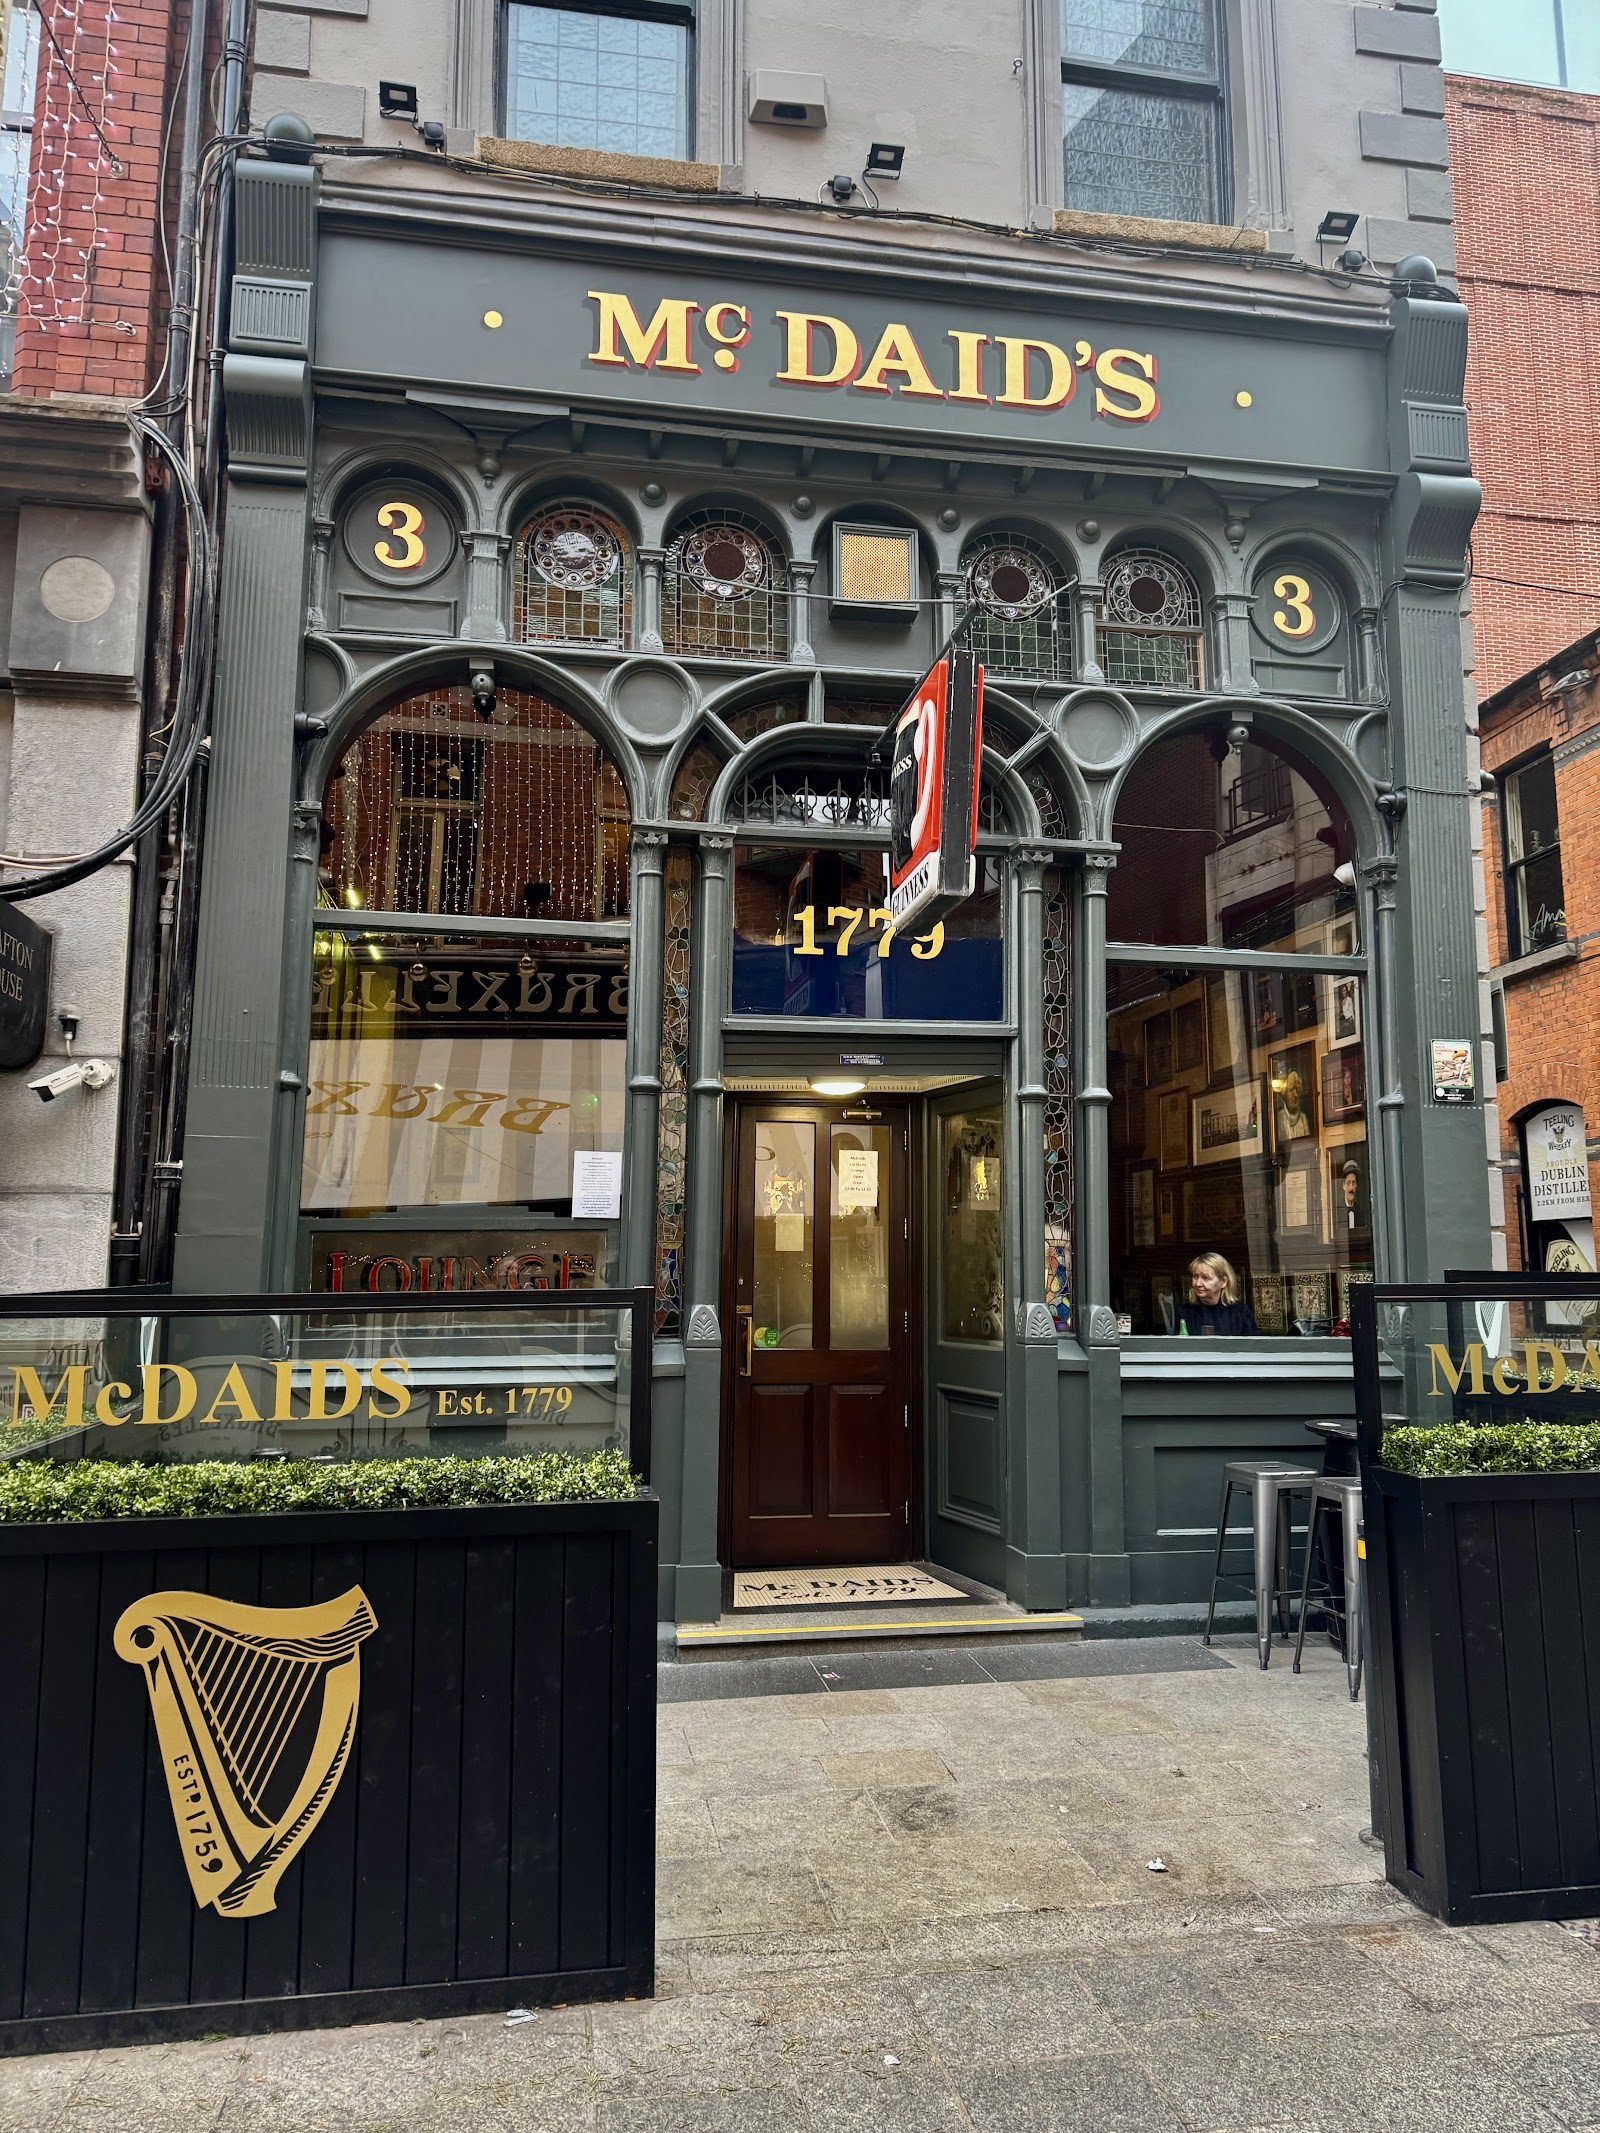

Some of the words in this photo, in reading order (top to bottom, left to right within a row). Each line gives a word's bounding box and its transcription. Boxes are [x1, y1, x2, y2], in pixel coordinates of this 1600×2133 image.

[775, 311, 1157, 421] DAID'S
[374, 502, 426, 569] 3
[1273, 574, 1316, 637] 3
[892, 862, 929, 920] GUINNESS
[0, 967, 24, 1001] USE
[1543, 1114, 1575, 1131] TEELING
[1541, 1165, 1585, 1182] DUBLIN
[1557, 1197, 1575, 1205] FROM
[8, 1358, 411, 1428] McDAIDS
[436, 1390, 493, 1416] Est.
[505, 1386, 573, 1414] 1779
[741, 1583, 798, 1592] Mc
[808, 1576, 934, 1590] DAIDS
[847, 1587, 917, 1597] 1779
[186, 1810, 223, 1873] 1759
